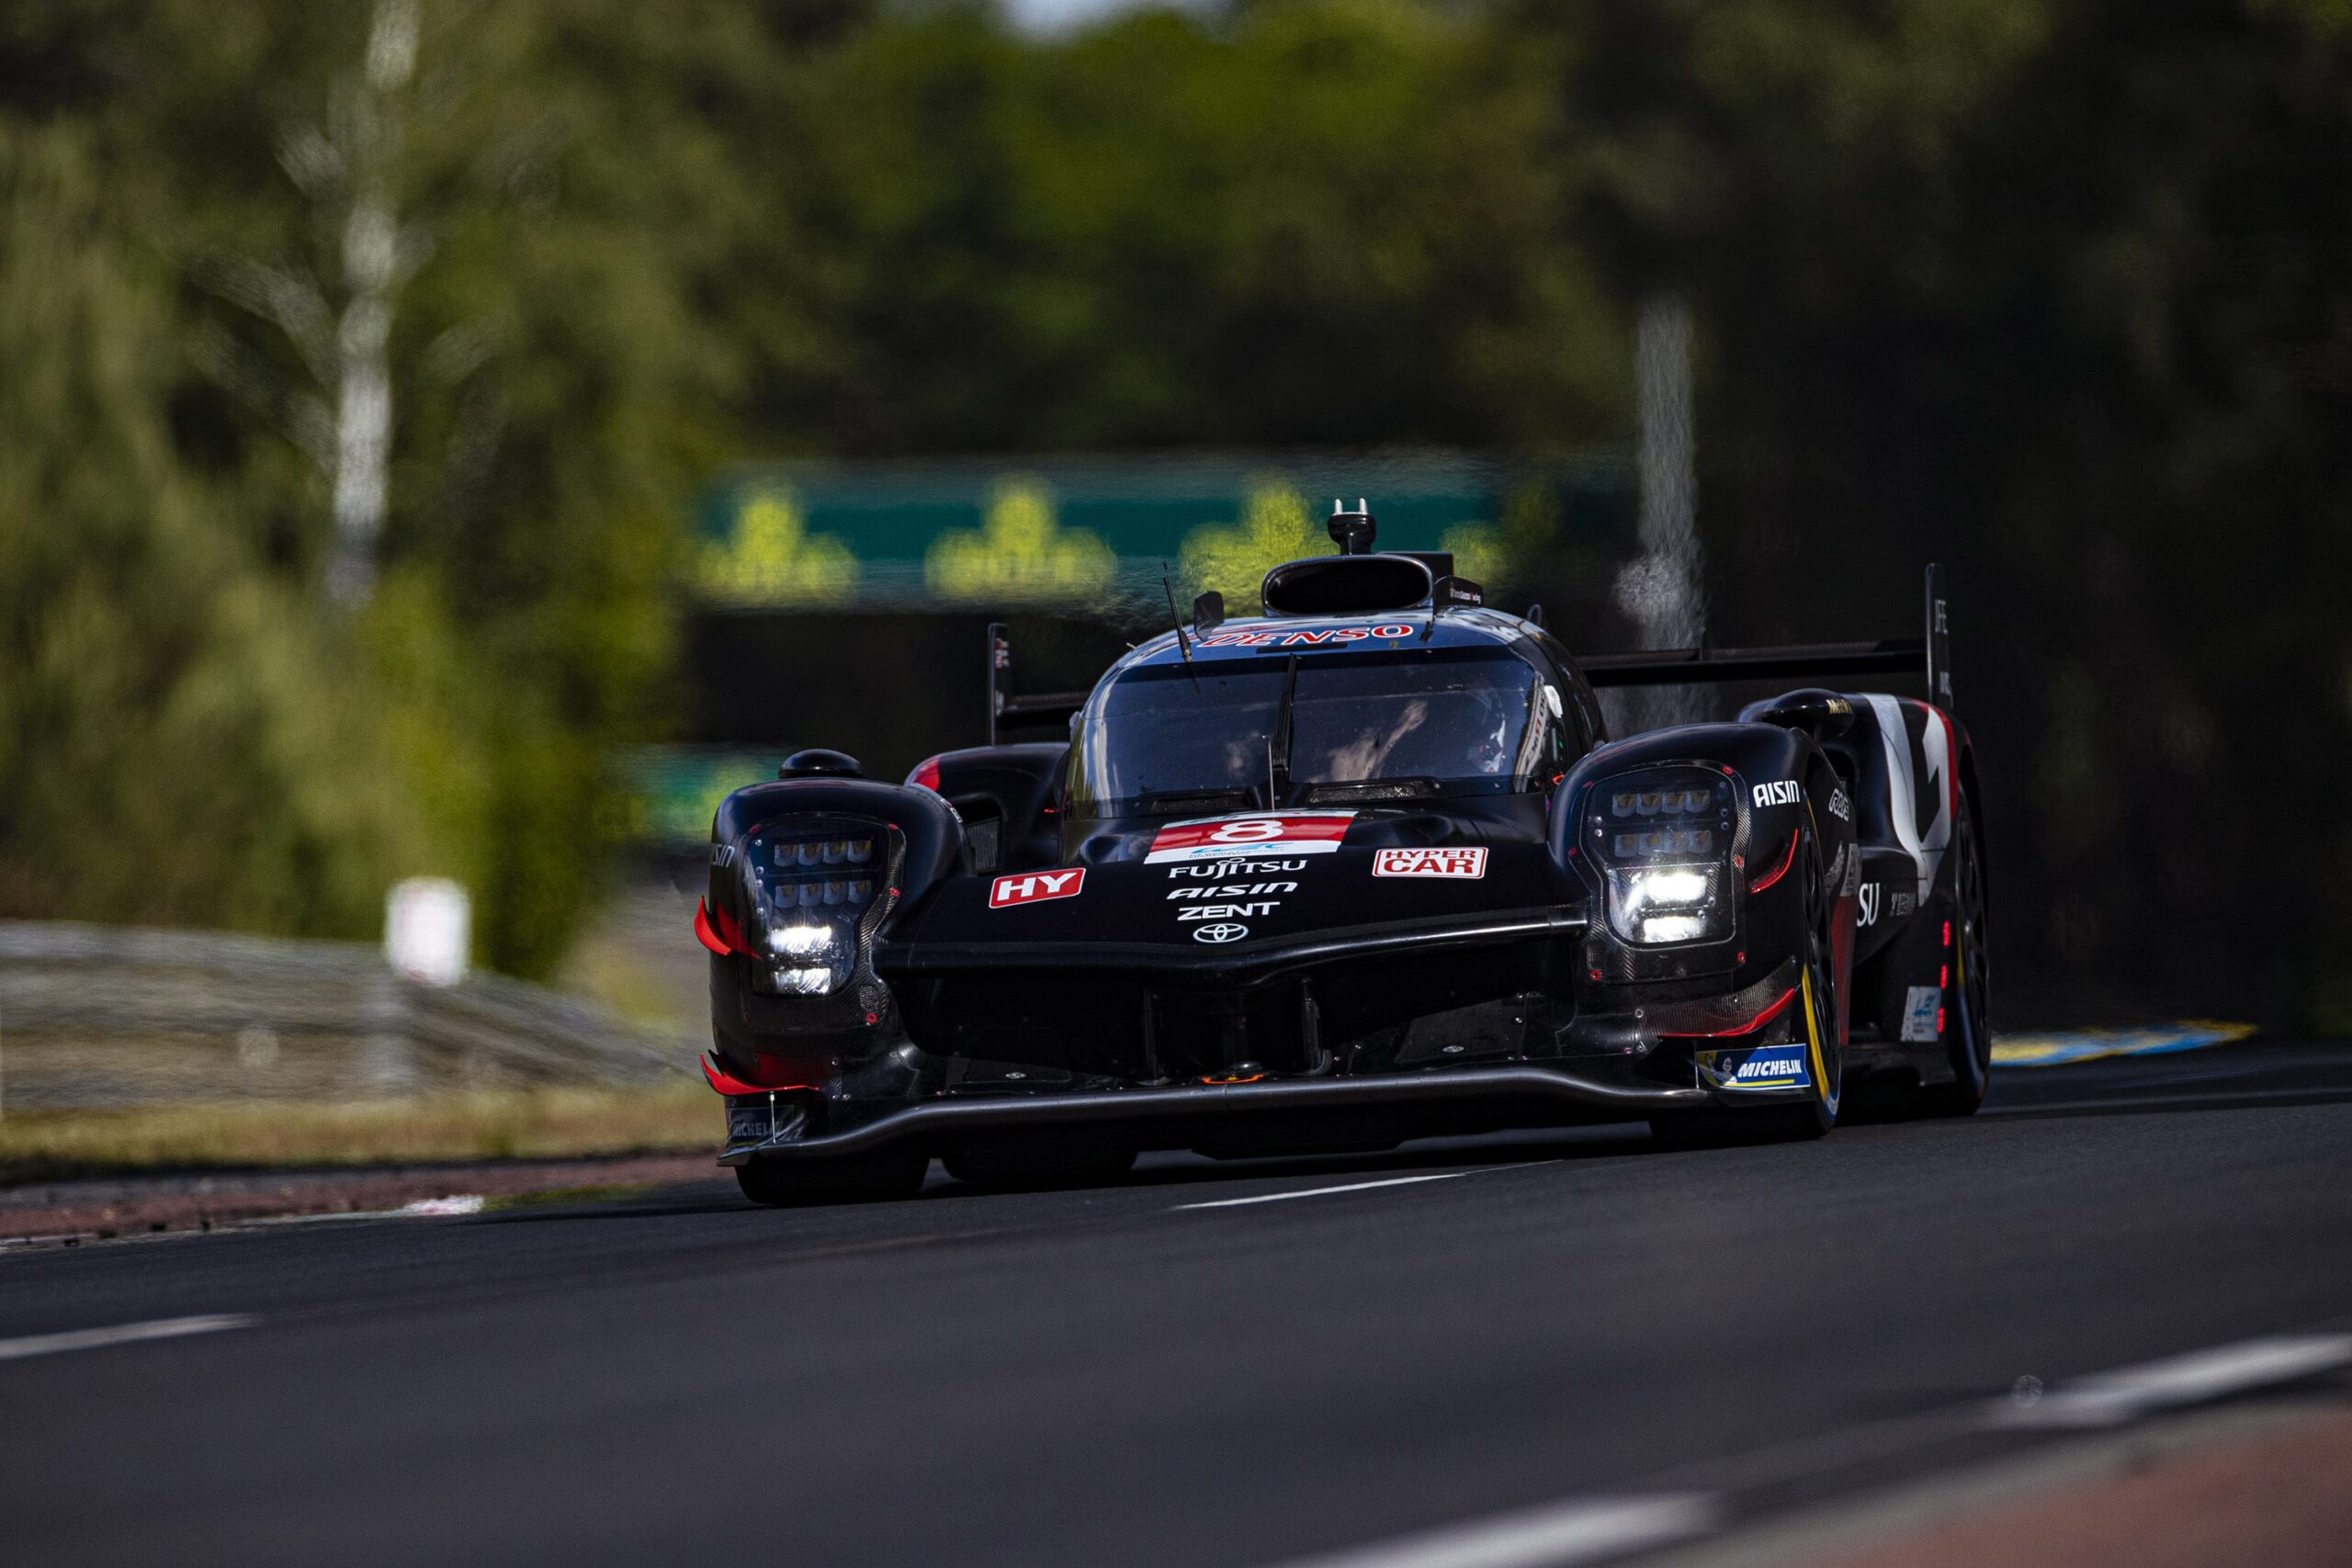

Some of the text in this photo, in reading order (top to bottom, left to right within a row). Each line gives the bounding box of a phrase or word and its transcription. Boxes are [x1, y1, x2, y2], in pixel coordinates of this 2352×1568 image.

[1197, 625, 1414, 649] DENSO
[1753, 780, 1801, 808] AISIN
[1210, 819, 1283, 842] 8
[1385, 850, 1477, 858] HYPER
[1168, 858, 1308, 880] FUJITSU
[1384, 859, 1474, 874] CAR
[997, 872, 1077, 901] HY
[1166, 882, 1298, 900] AISIN
[1177, 901, 1280, 921] ZENT
[1737, 1059, 1803, 1077] MICHELIN
